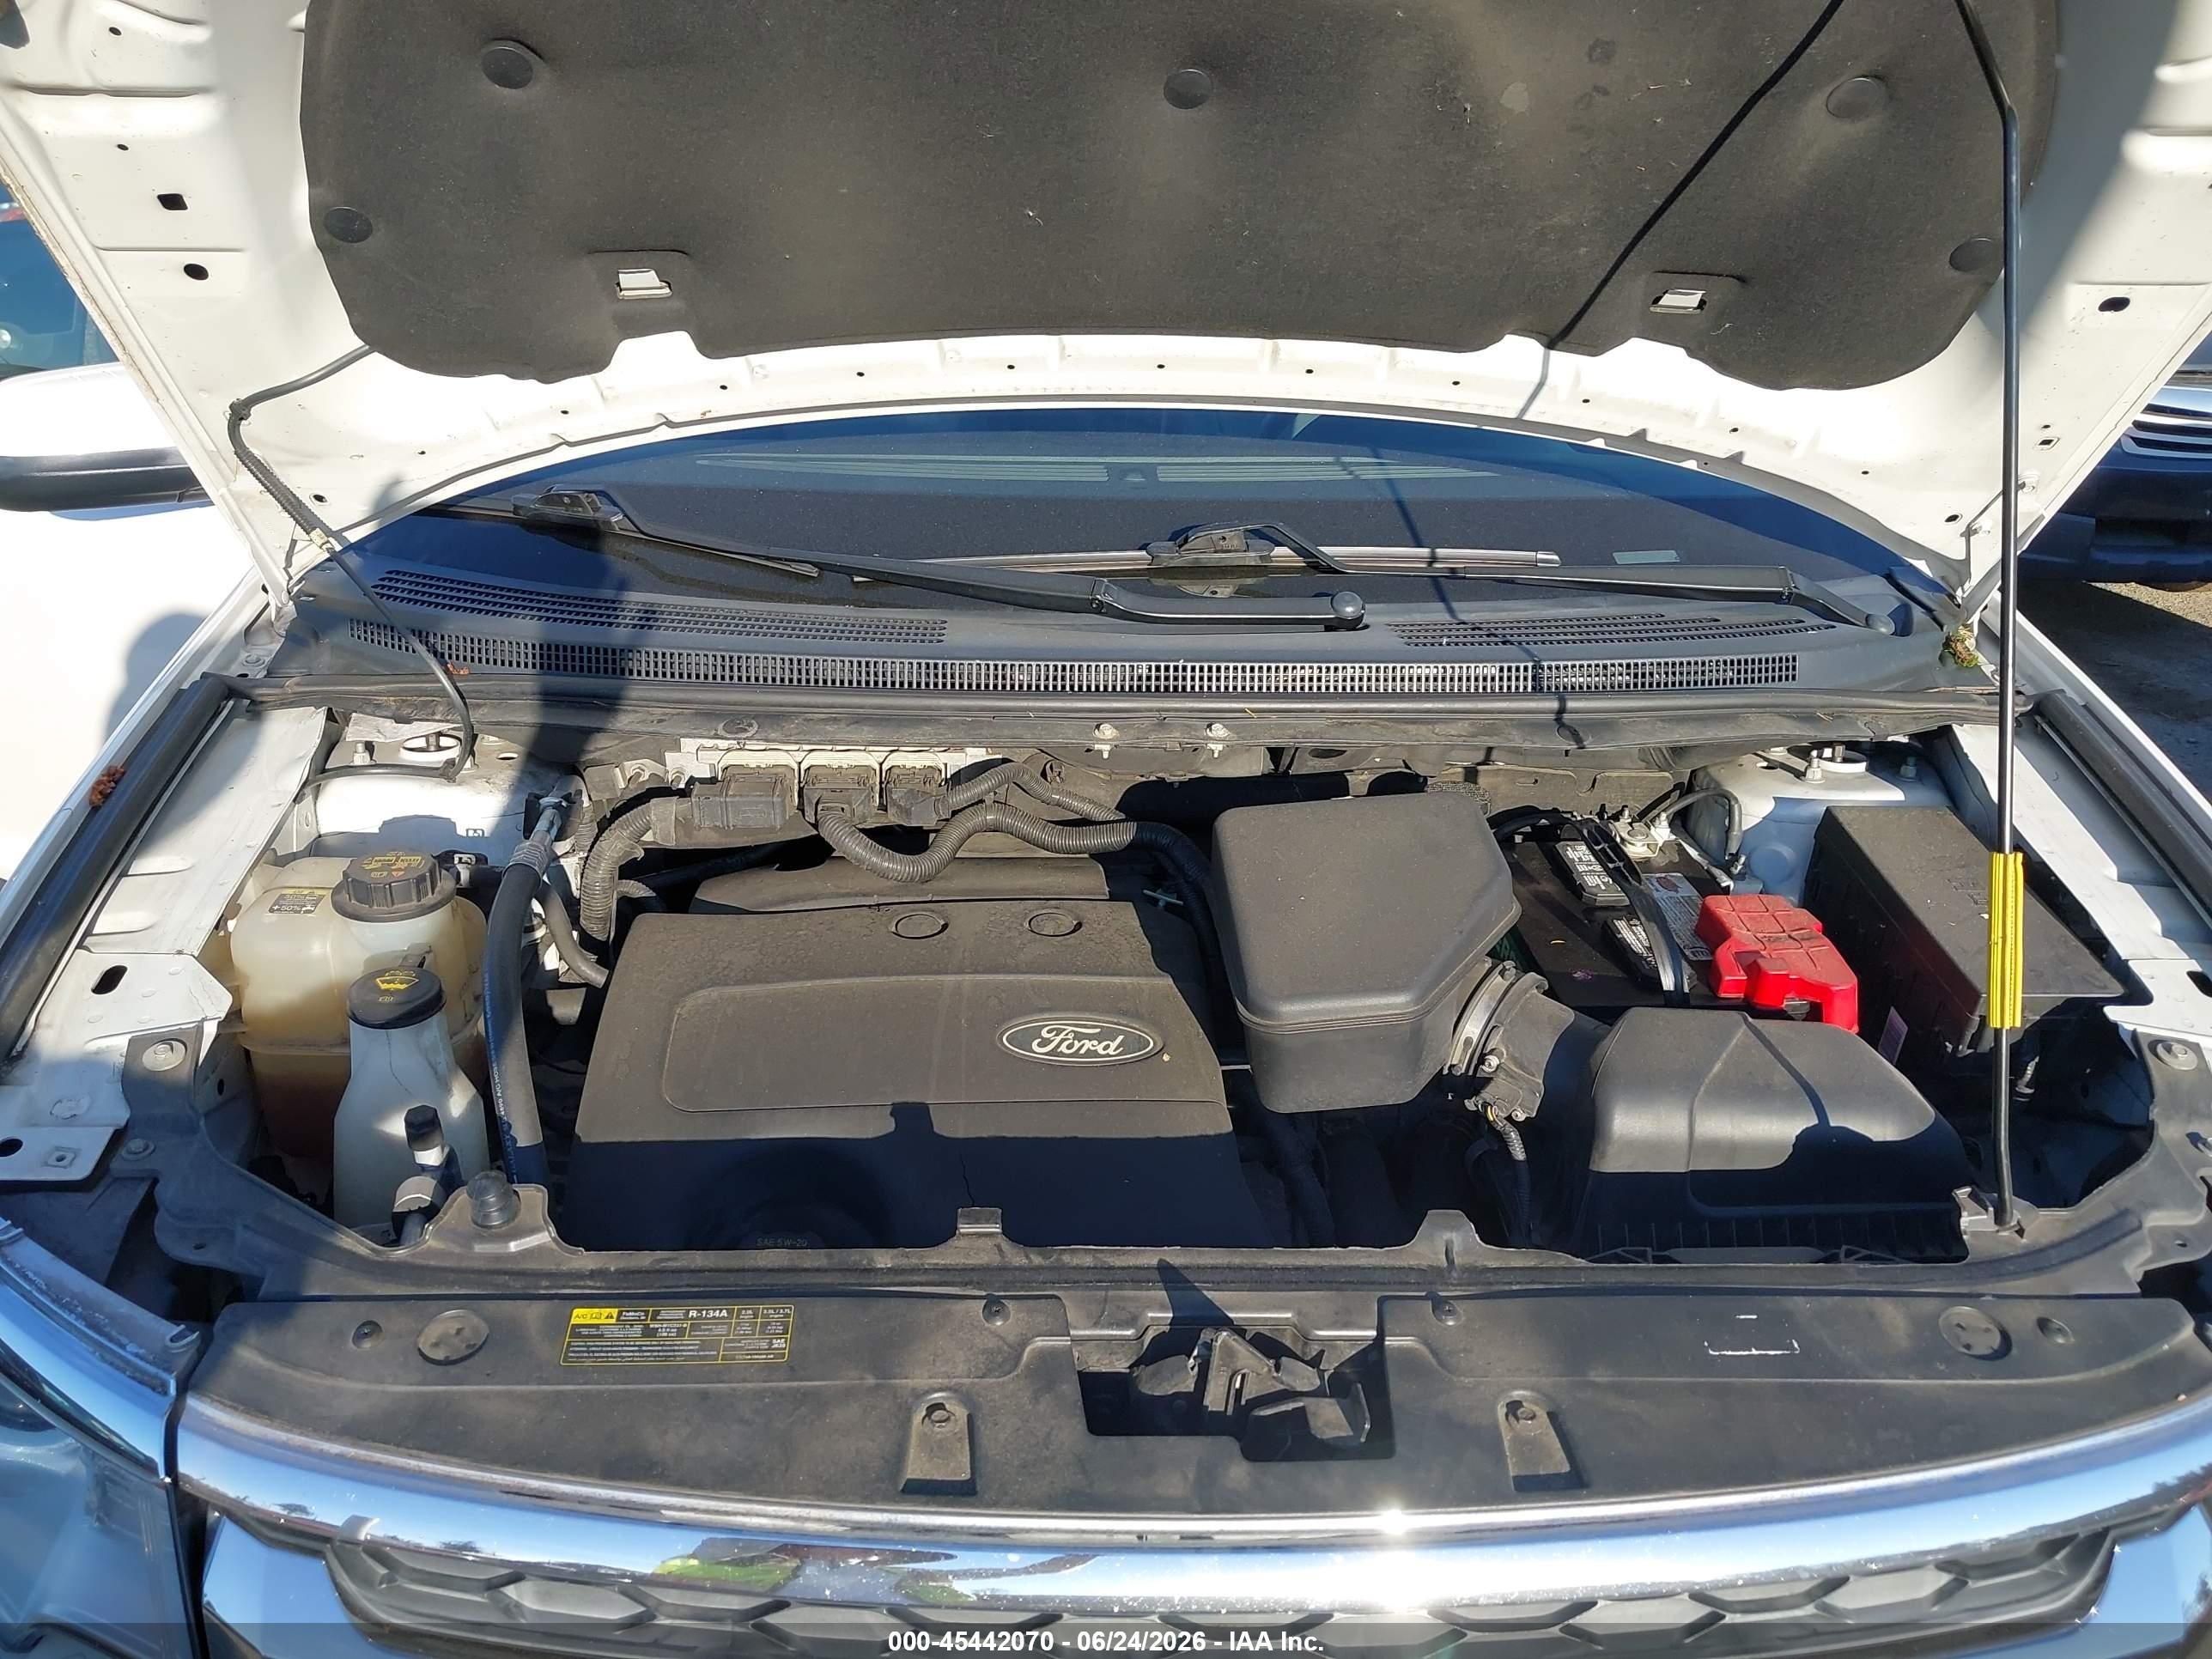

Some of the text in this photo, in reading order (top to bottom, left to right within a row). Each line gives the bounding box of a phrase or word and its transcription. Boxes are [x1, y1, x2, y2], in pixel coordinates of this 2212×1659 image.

[1031, 1024, 1126, 1055] Ford
[756, 1237, 808, 1247] SAE 5W-20
[688, 1310, 728, 1318] R-134A
